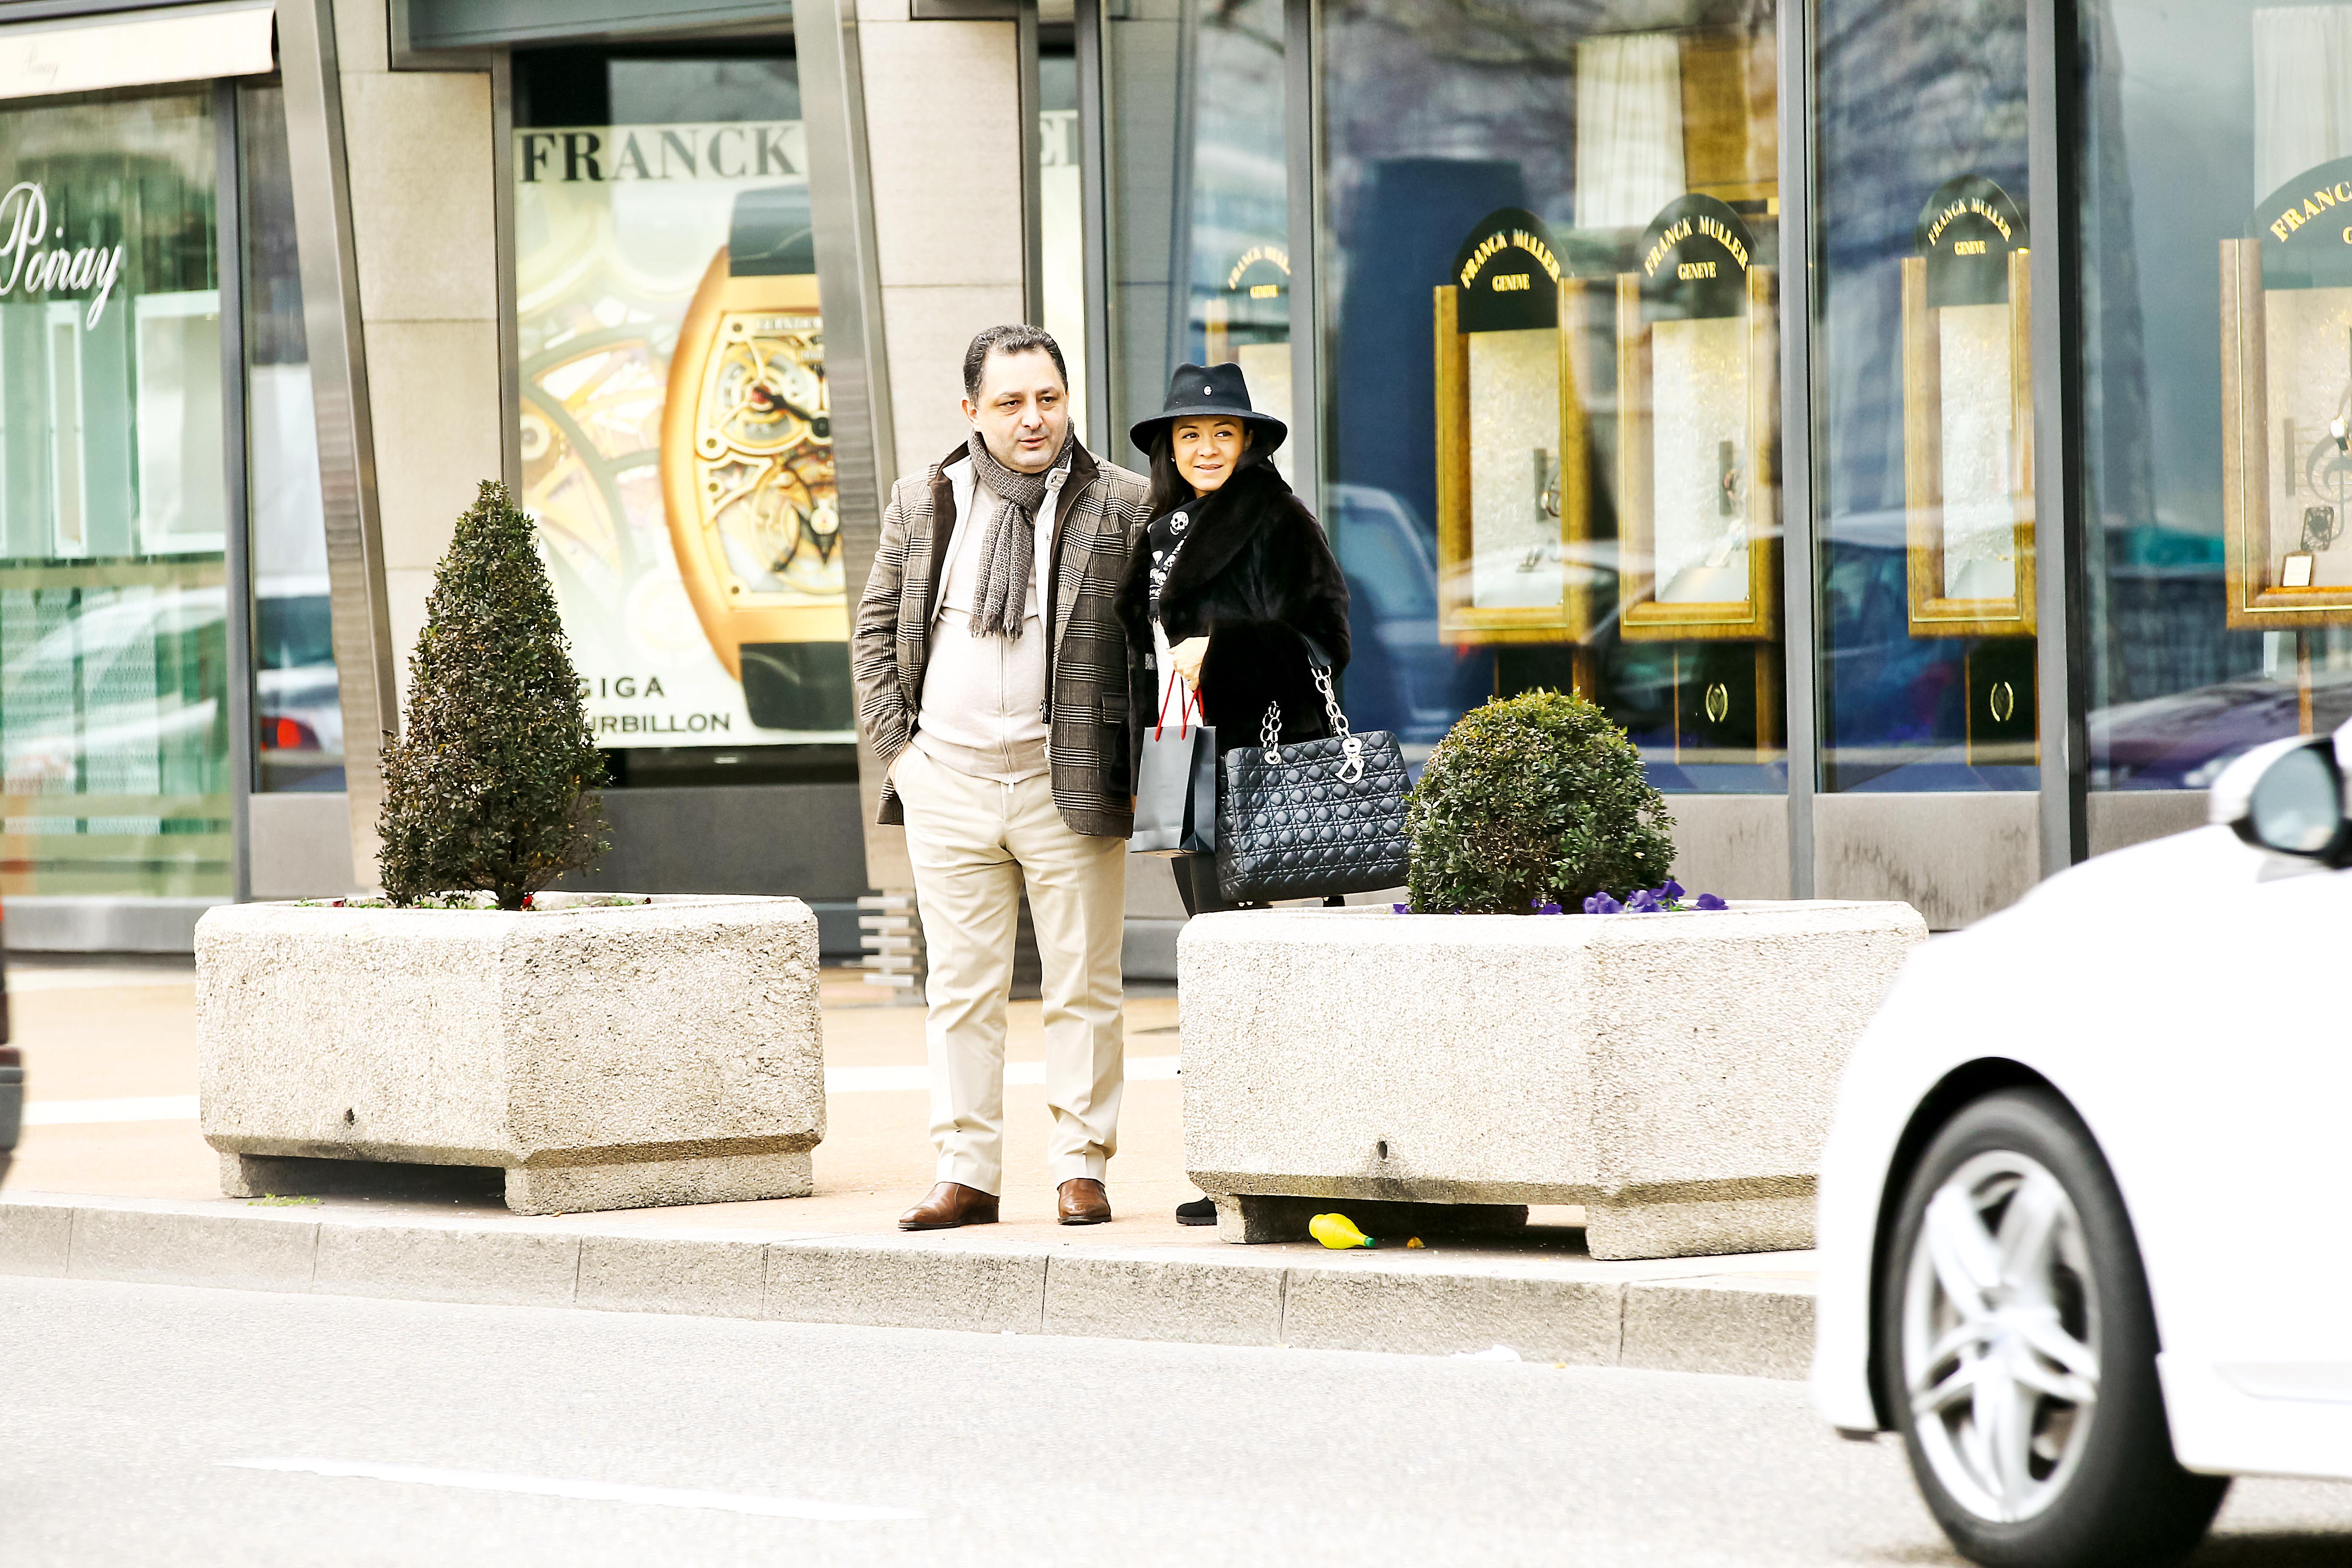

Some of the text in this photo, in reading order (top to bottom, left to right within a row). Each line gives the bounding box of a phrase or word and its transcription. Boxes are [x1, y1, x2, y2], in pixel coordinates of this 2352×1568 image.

[520, 126, 801, 182] FRANCK
[1644, 215, 1749, 278] FRANCK MULLER
[1928, 197, 2012, 246] FRANCK MULLER
[0, 182, 122, 331] Poiray
[1460, 228, 1560, 289] FRANCK MULLER
[1678, 261, 1717, 280] GENEVE
[578, 676, 665, 698] GIGA
